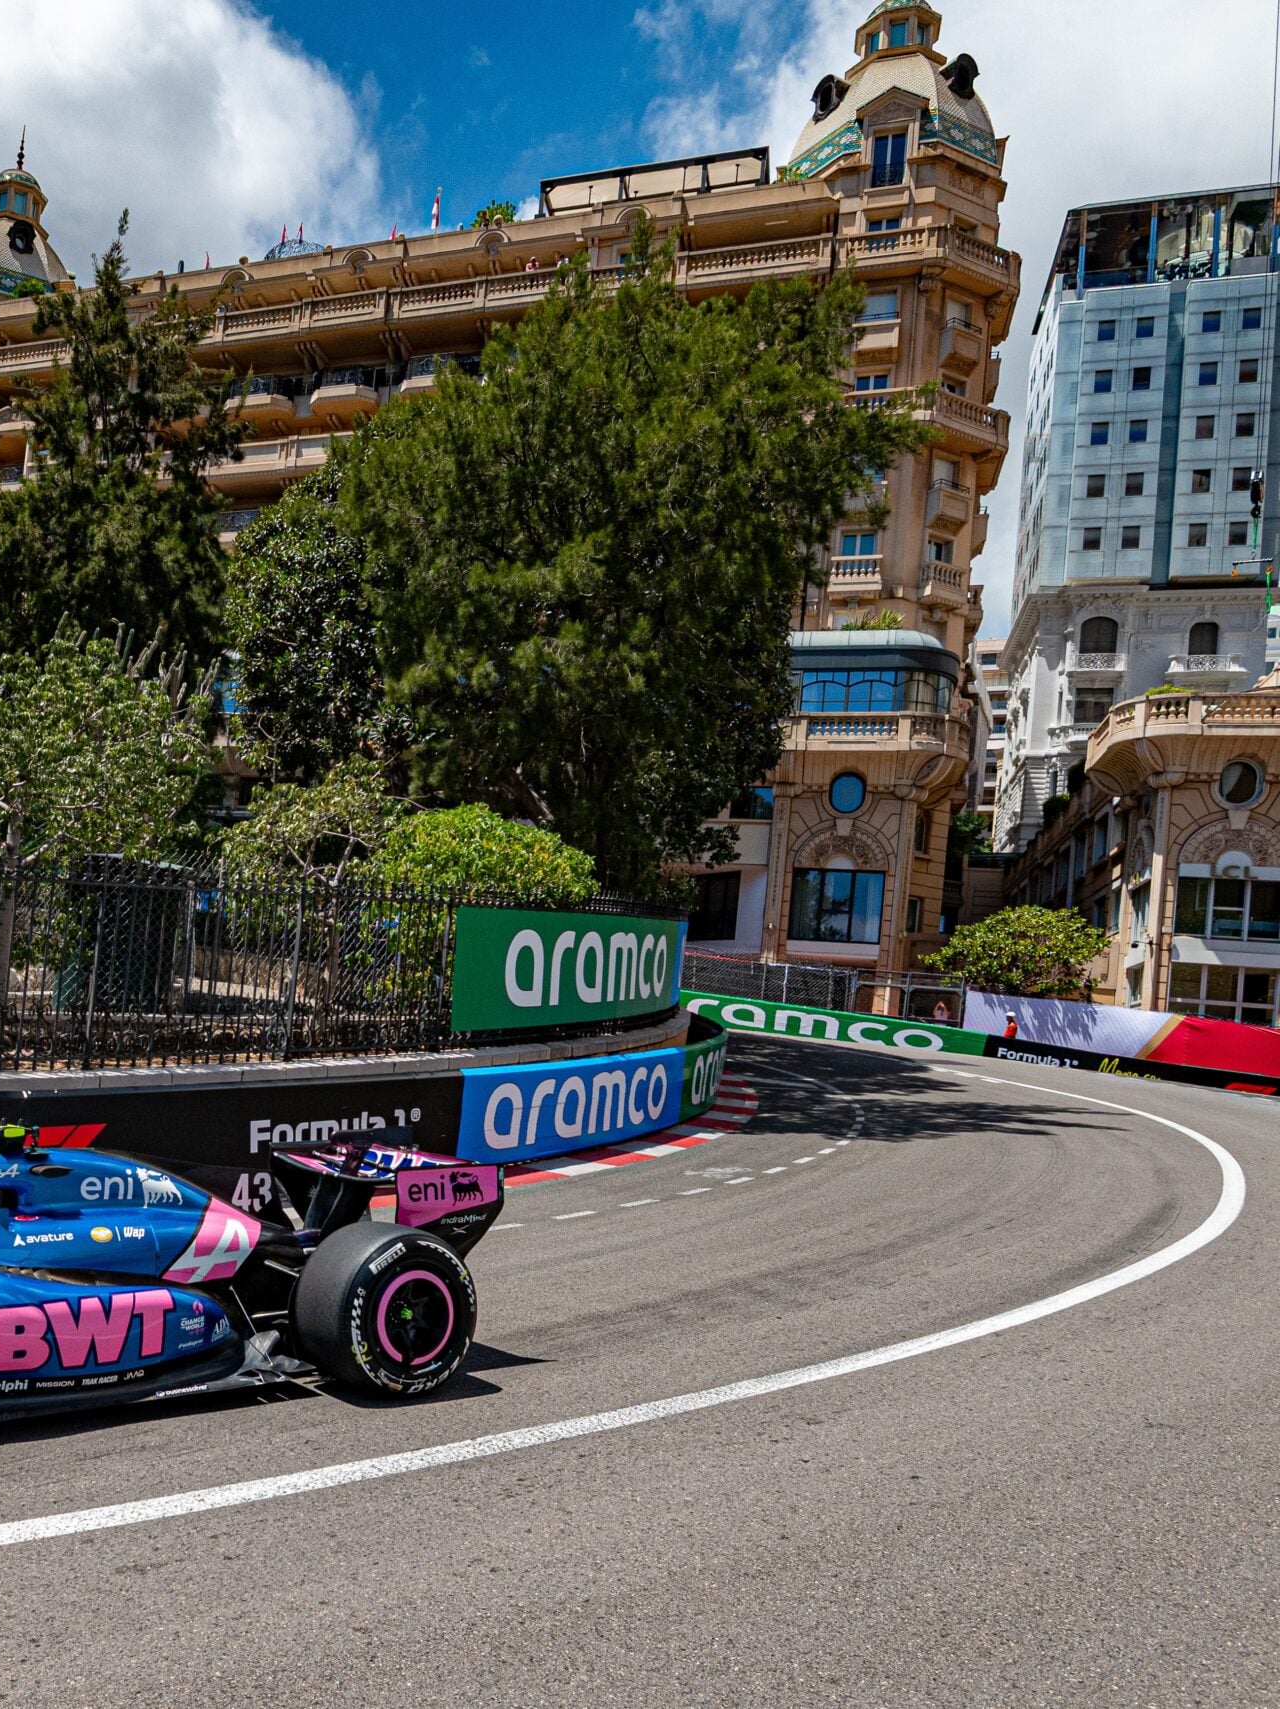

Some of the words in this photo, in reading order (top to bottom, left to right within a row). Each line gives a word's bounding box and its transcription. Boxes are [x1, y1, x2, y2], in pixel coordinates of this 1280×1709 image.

[505, 929, 667, 1008] aramco
[997, 1047, 1061, 1067] Formula
[483, 1064, 667, 1150] aramco
[80, 1168, 133, 1201] eni
[231, 1172, 273, 1213] 43
[408, 1175, 445, 1202] eni
[26, 1232, 74, 1244] avature
[123, 1227, 145, 1239] Wap
[368, 1242, 406, 1275] PIRELLI
[36, 1380, 75, 1388] MISSION
[82, 1378, 98, 1386] TRAK
[98, 1375, 118, 1384] RACER
